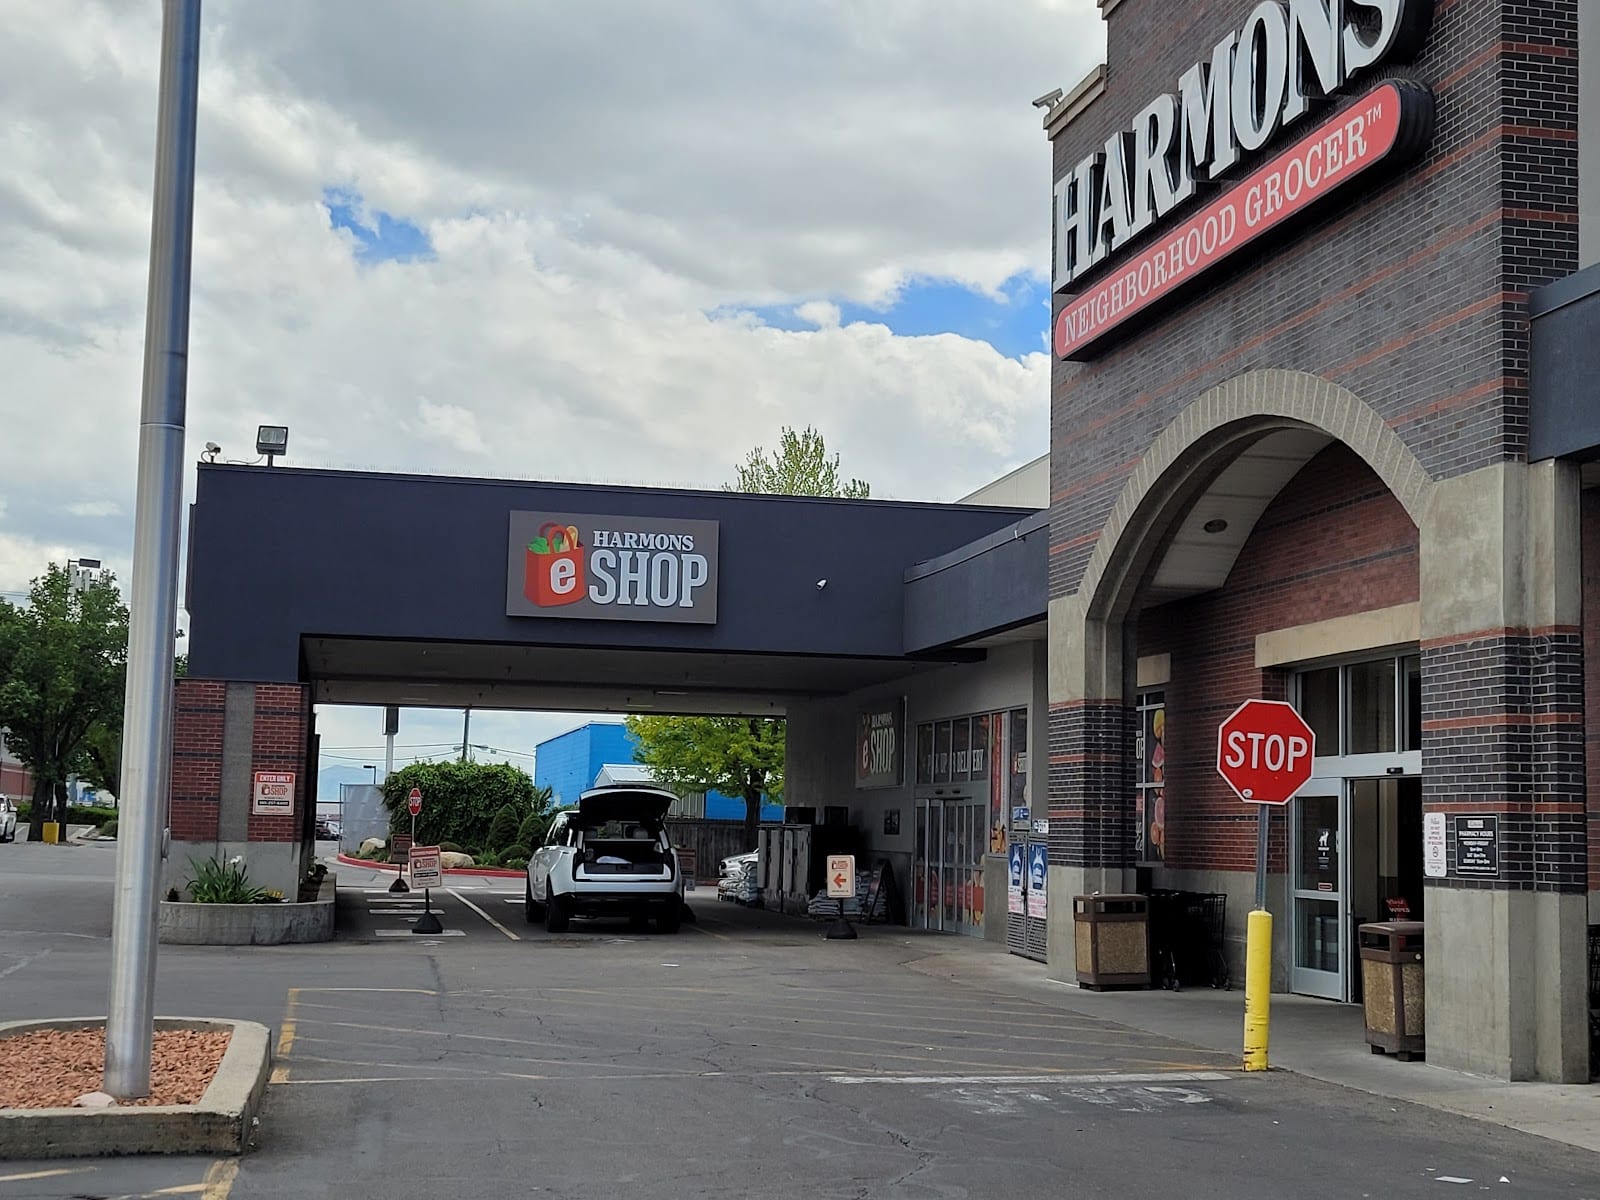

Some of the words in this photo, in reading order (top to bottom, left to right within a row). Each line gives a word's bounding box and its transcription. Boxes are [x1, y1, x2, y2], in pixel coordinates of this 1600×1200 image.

[1064, 204, 1236, 347] NEIGHBORHOOD
[593, 530, 694, 551] HARMONS
[588, 549, 708, 608] SHOP
[870, 727, 896, 776] SHOP
[957, 749, 985, 773] DELERY
[1225, 730, 1308, 772] STOP
[410, 796, 421, 807] STOP
